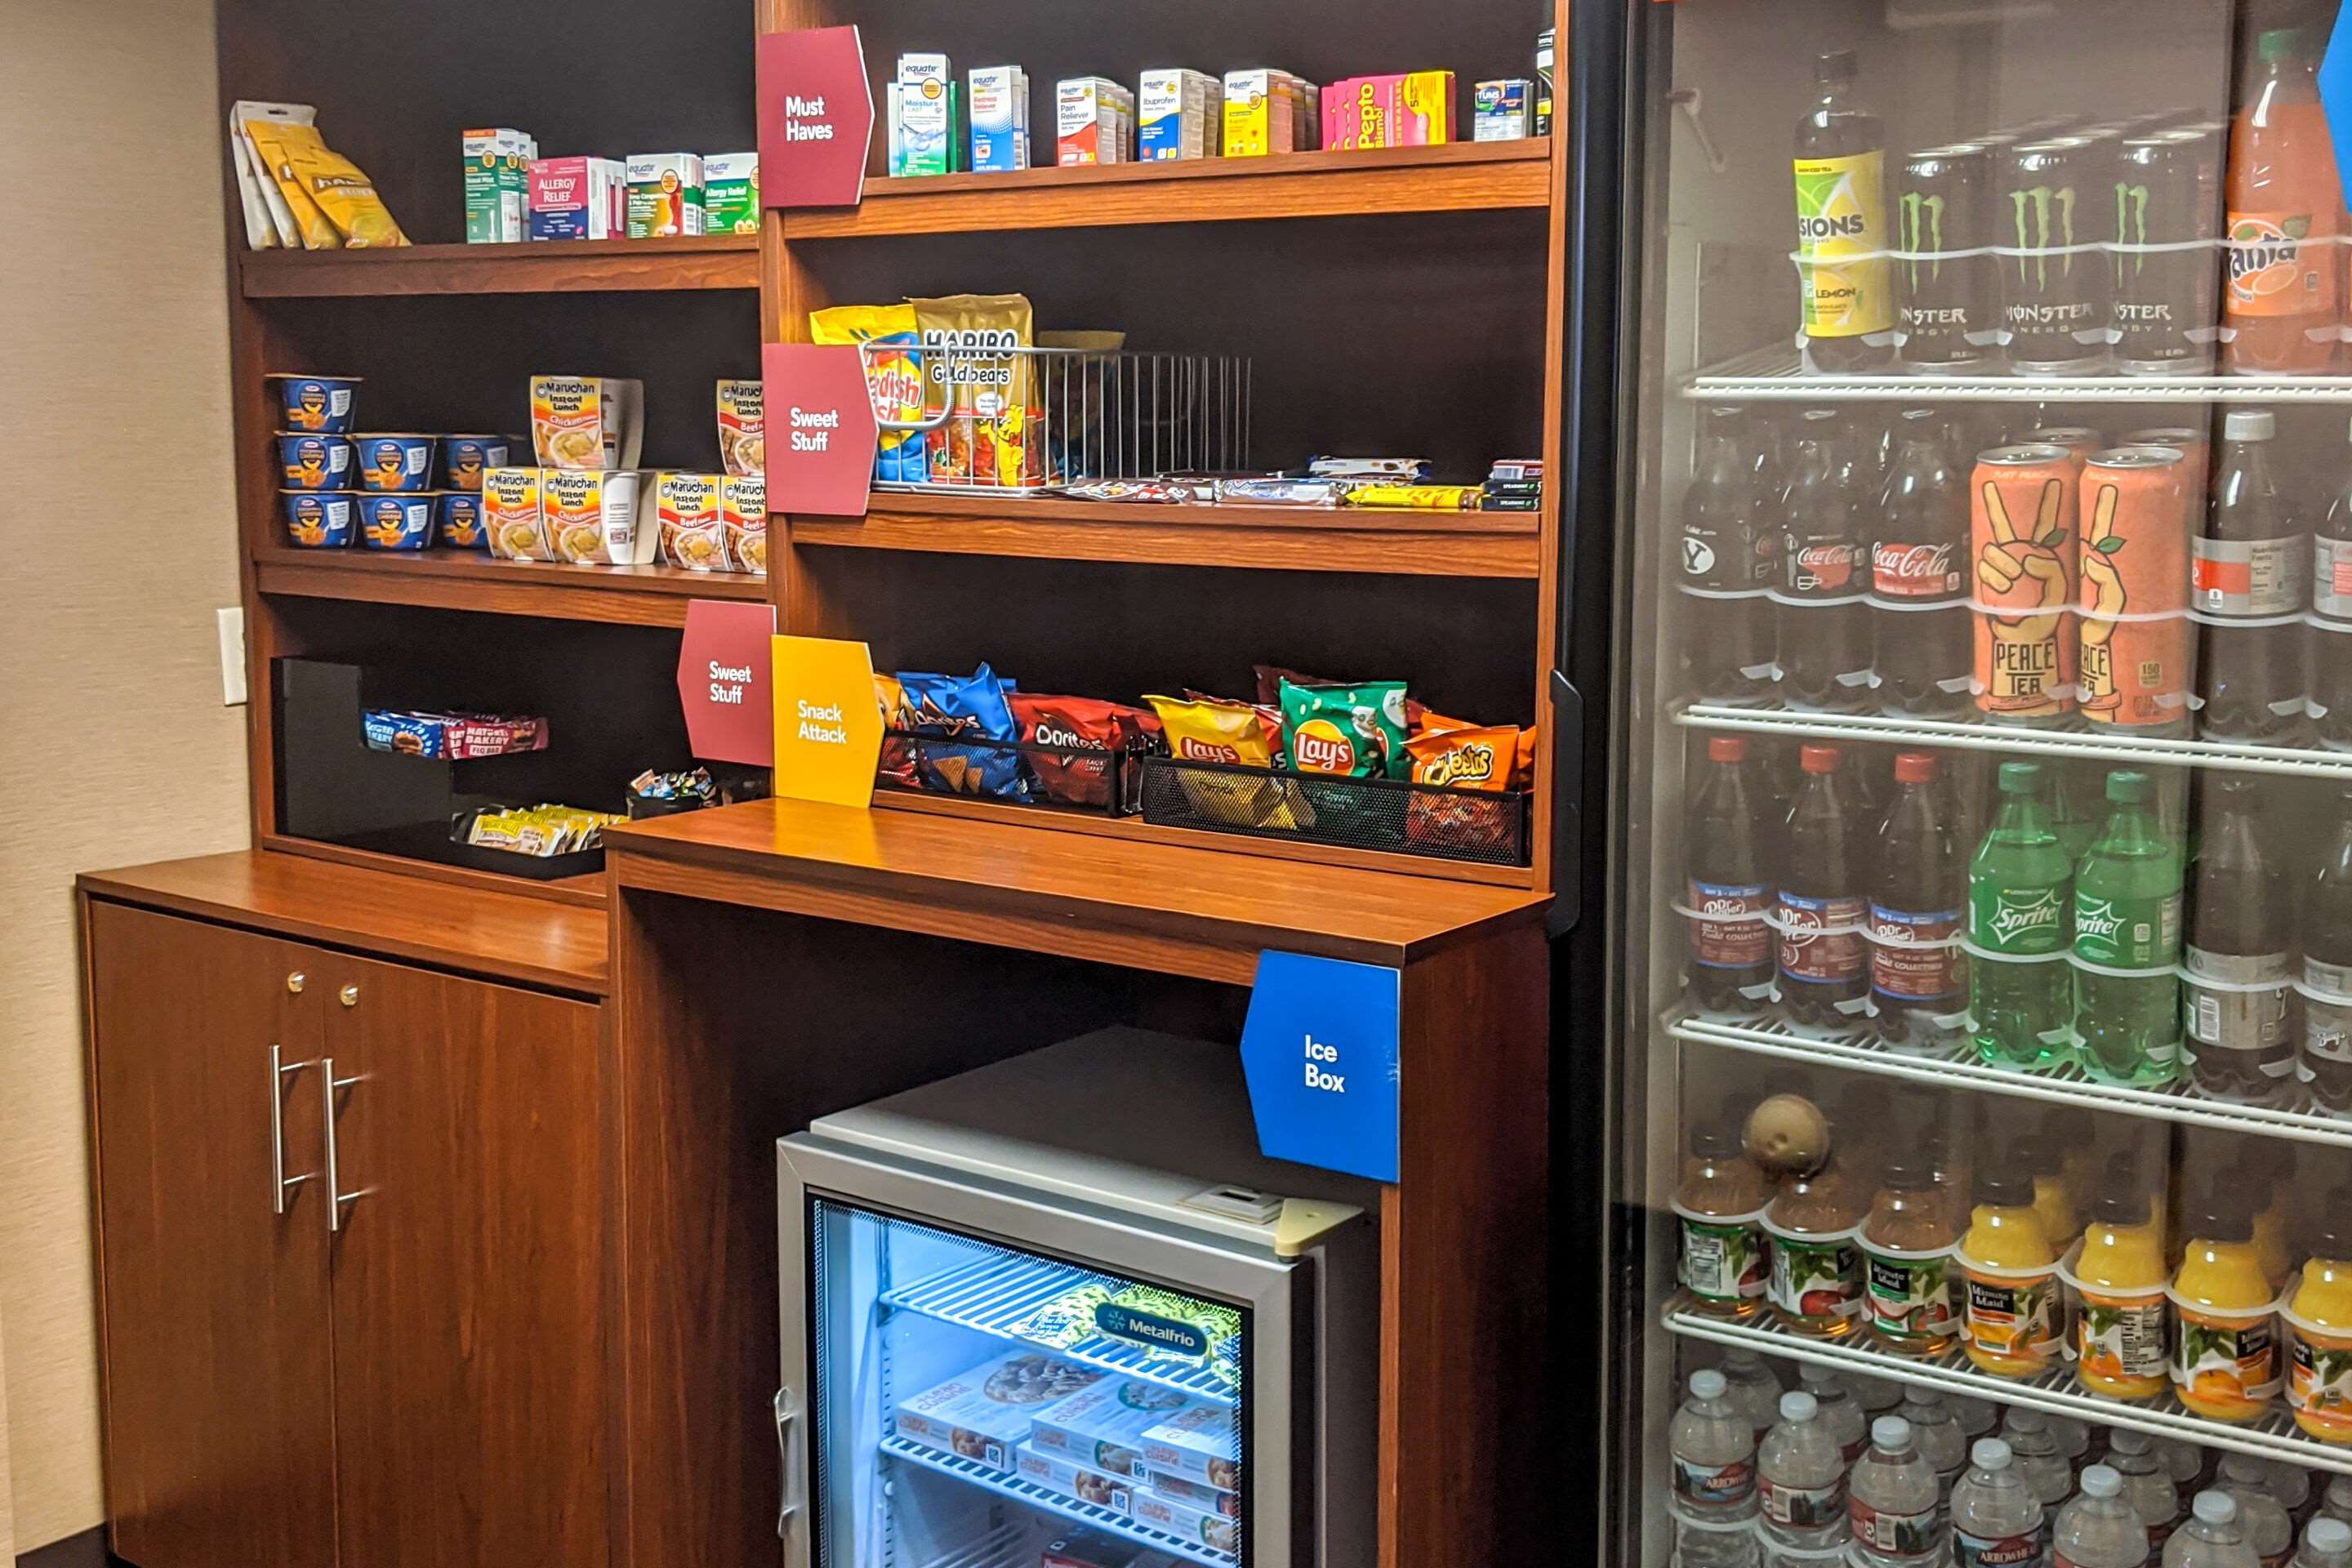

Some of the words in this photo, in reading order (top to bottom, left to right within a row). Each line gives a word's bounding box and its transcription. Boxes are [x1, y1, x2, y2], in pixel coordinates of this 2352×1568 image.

[906, 65, 938, 74] equate
[1143, 96, 1177, 105] Ibuprofen
[1478, 90, 1500, 100] TUMS
[786, 96, 826, 118] Must
[1060, 112, 1089, 120] Reliever
[1358, 82, 1375, 149] Pepto
[786, 120, 834, 142] Haves
[1374, 107, 1386, 149] Bismol
[628, 163, 655, 174] equate
[705, 163, 730, 172] equate
[538, 177, 577, 190] ALLERGY
[543, 190, 572, 203] RELIEF
[706, 188, 728, 198] Allergy
[728, 186, 747, 196] Relief
[1798, 213, 1865, 238] SIONS
[1815, 287, 1857, 299] LEMON
[925, 331, 1017, 359] HARIBO
[546, 381, 595, 394] Maruchan
[549, 394, 583, 404] Instant
[552, 403, 580, 412] Lunch
[737, 408, 762, 416] Lunch
[549, 414, 581, 426] Chicken
[791, 408, 840, 428] Sweet
[741, 421, 760, 432] Beef
[791, 430, 829, 452] Stuff
[495, 474, 536, 487] Maruchan
[555, 478, 598, 490] Maruchan
[497, 486, 525, 497] Instant
[558, 489, 586, 499] Instant
[670, 481, 715, 494] Maruchan
[500, 495, 523, 504] Lunch
[561, 497, 584, 507] Lunch
[673, 493, 703, 504] Instant
[676, 502, 701, 512] Lunch
[739, 505, 762, 514] Lunch
[679, 516, 698, 527] Beef
[742, 519, 760, 530] Beef
[1685, 540, 1707, 572] Y
[1797, 545, 1855, 566] Coca-Cola
[1873, 541, 1954, 577] Coca-Cola
[1995, 642, 2056, 671] PEACE
[709, 661, 752, 683] Sweet
[2142, 663, 2161, 675] 150
[2011, 675, 2041, 695] TEA
[710, 683, 743, 704] Stuff
[797, 700, 842, 722] Snack
[798, 722, 848, 744] Attack
[1036, 724, 1107, 751] Doritos
[466, 736, 510, 746] BAKERY
[1184, 737, 1237, 764] Lay's
[1297, 733, 1350, 771] Lay's
[1423, 744, 1493, 786] Cheetos
[1996, 906, 2057, 931] Sprite
[1304, 1033, 1339, 1062] Ice
[1304, 1062, 1346, 1094] Box
[1971, 1284, 2010, 1301] Minute
[1975, 1295, 2005, 1308] Maid
[1128, 1317, 1196, 1348] Metalfrio
[1980, 1546, 2035, 1564] ARROWHE
